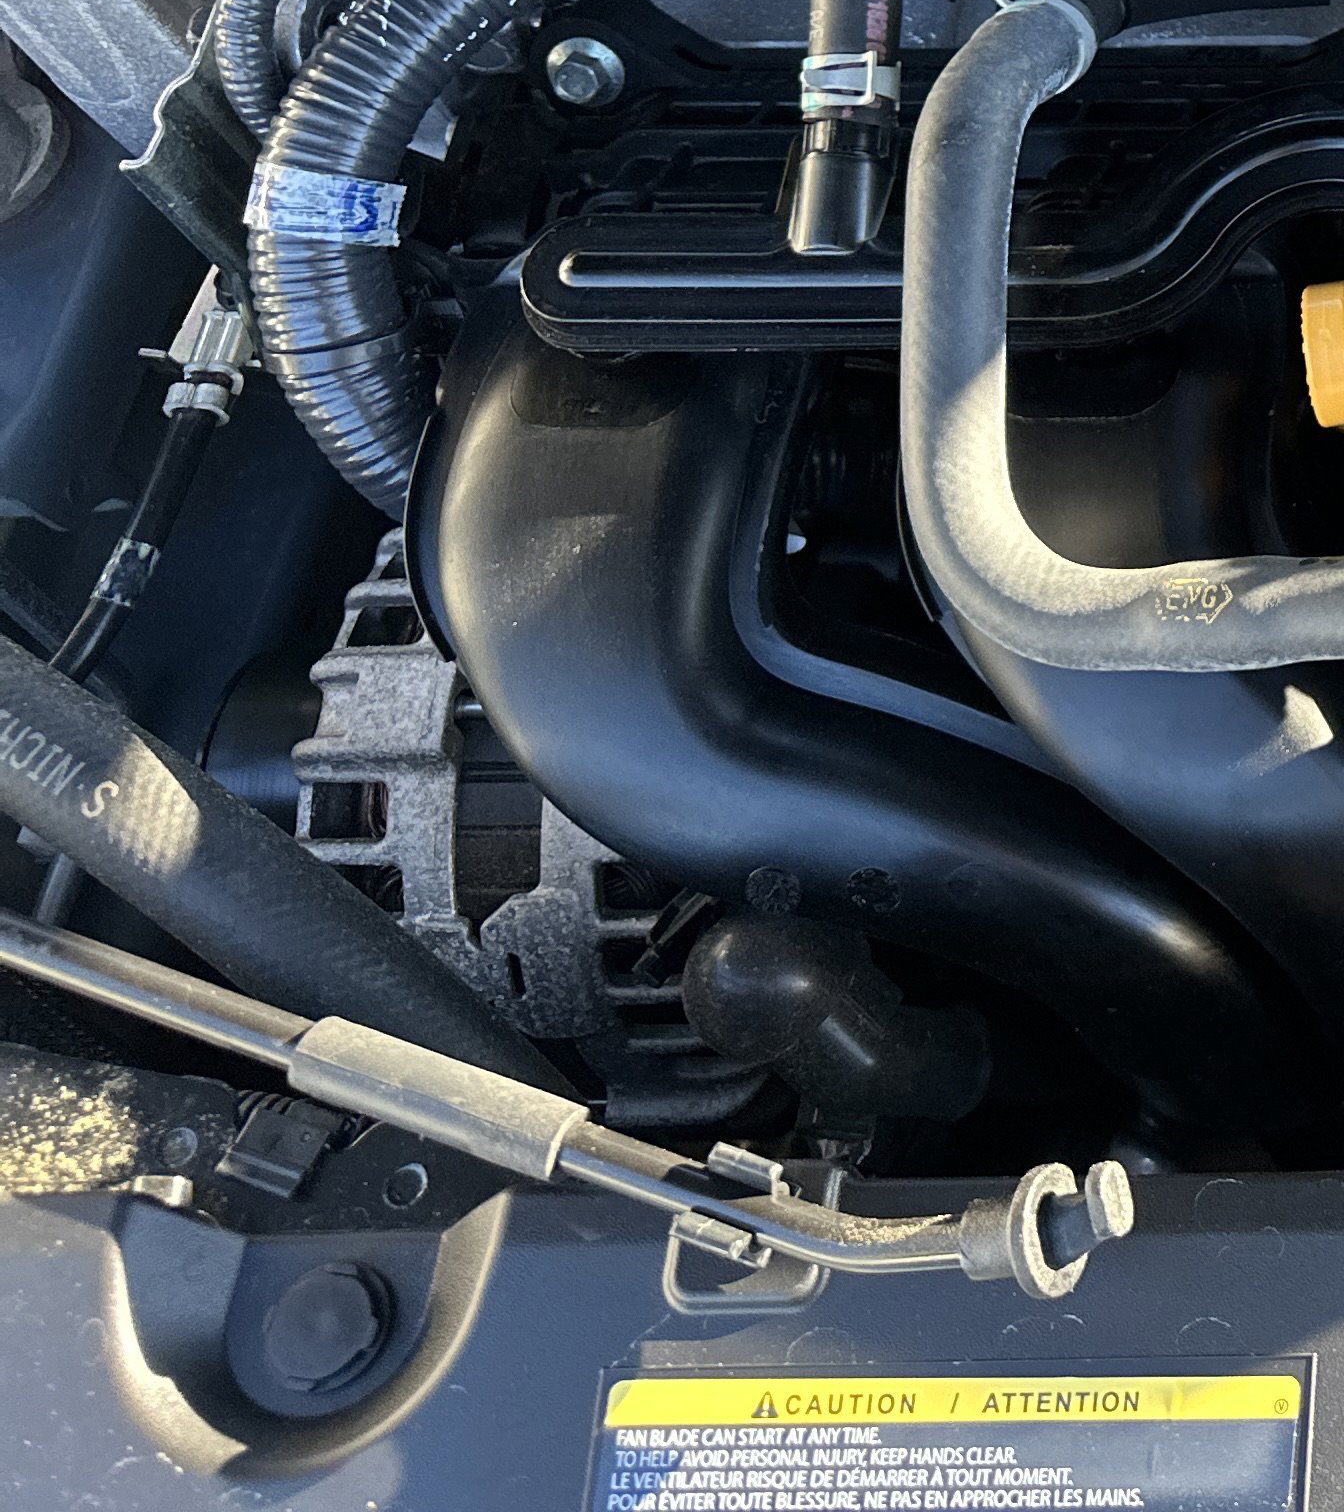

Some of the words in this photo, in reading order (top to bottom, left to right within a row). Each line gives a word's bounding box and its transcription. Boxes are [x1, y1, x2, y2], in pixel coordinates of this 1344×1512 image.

[785, 1393, 917, 1415] CAUTION
[950, 1392, 959, 1414] /
[981, 1391, 1141, 1414] ATTENTION
[616, 1429, 648, 1447] FAN
[650, 1429, 700, 1447] BLADE
[701, 1429, 737, 1446] CAN
[738, 1428, 783, 1446] START
[785, 1428, 807, 1445] AT
[810, 1428, 844, 1445] ANY
[844, 1427, 881, 1445] TIME.
[615, 1450, 637, 1467] TO
[639, 1450, 678, 1467] HELP
[680, 1449, 729, 1467] AVOID
[731, 1449, 810, 1467] PERSONAL
[812, 1448, 868, 1468] INJURY,
[870, 1448, 907, 1466] KEEP
[909, 1447, 964, 1465] HANDS
[966, 1447, 1018, 1464] CLEAR.
[610, 1472, 630, 1489] LE
[633, 1470, 744, 1489] VENTILATEUR
[745, 1470, 808, 1489] RISQUE
[810, 1470, 834, 1488] DE
[836, 1467, 928, 1488] DÉMARRER
[929, 1466, 944, 1486] À
[946, 1468, 992, 1486] TOUT
[993, 1467, 1074, 1486] MOMENT.
[607, 1492, 657, 1510] POUR
[658, 1490, 716, 1510] ÉVITER
[718, 1492, 775, 1510] TOUTE
[775, 1491, 861, 1510] BLESSURE,
[864, 1491, 888, 1509] NE
[890, 1490, 922, 1508] PAS
[924, 1490, 948, 1508] EN
[950, 1489, 1052, 1508] APPROCHER
[1053, 1489, 1084, 1506] LES
[1085, 1488, 1146, 1506] MAINS.
